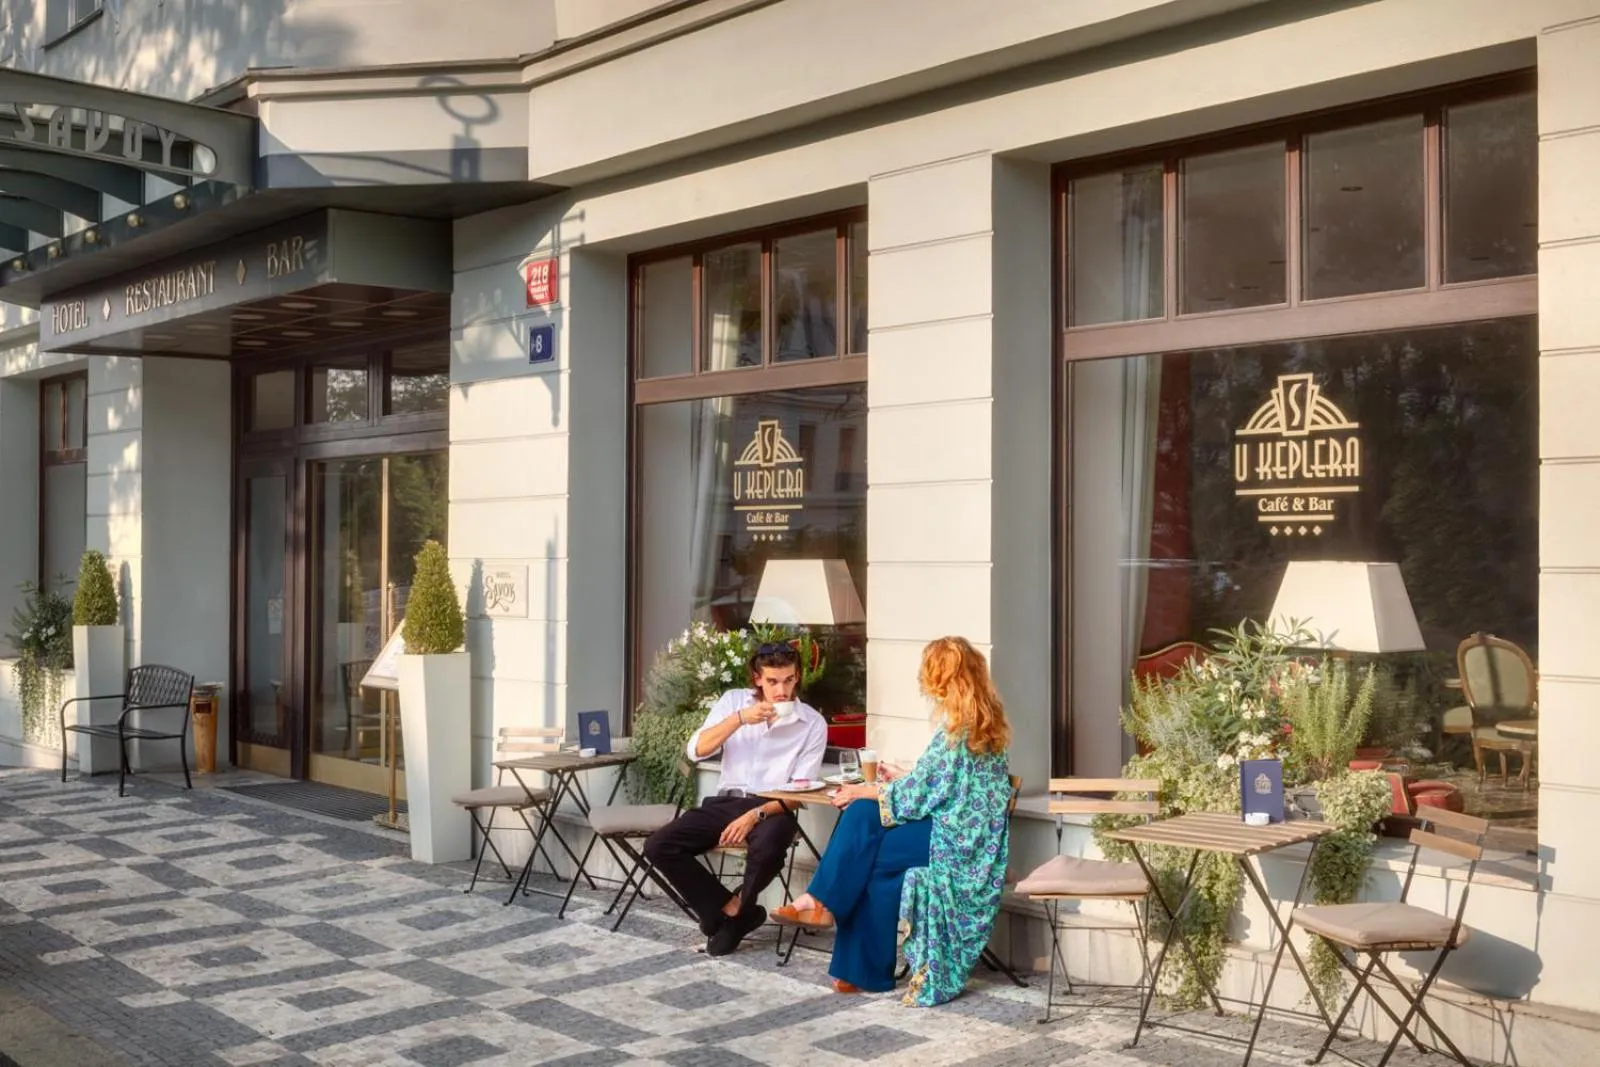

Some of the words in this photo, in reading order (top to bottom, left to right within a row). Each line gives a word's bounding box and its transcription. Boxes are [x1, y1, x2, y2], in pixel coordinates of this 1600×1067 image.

[13, 102, 176, 168] SAVOY
[51, 300, 88, 335] HOTEL
[124, 261, 216, 317] RESTAURANT
[266, 236, 304, 278] BAR
[531, 264, 549, 286] 218
[535, 334, 543, 353] 8
[1235, 443, 1248, 482] U
[1255, 436, 1360, 481] KEPLERA
[734, 471, 742, 501] U
[745, 468, 803, 499] KEPLERA
[746, 512, 764, 524] Café
[765, 512, 774, 524] &
[774, 511, 790, 523] Bar
[1258, 496, 1289, 512] Café
[1292, 498, 1305, 512] &
[1308, 497, 1334, 512] Bar
